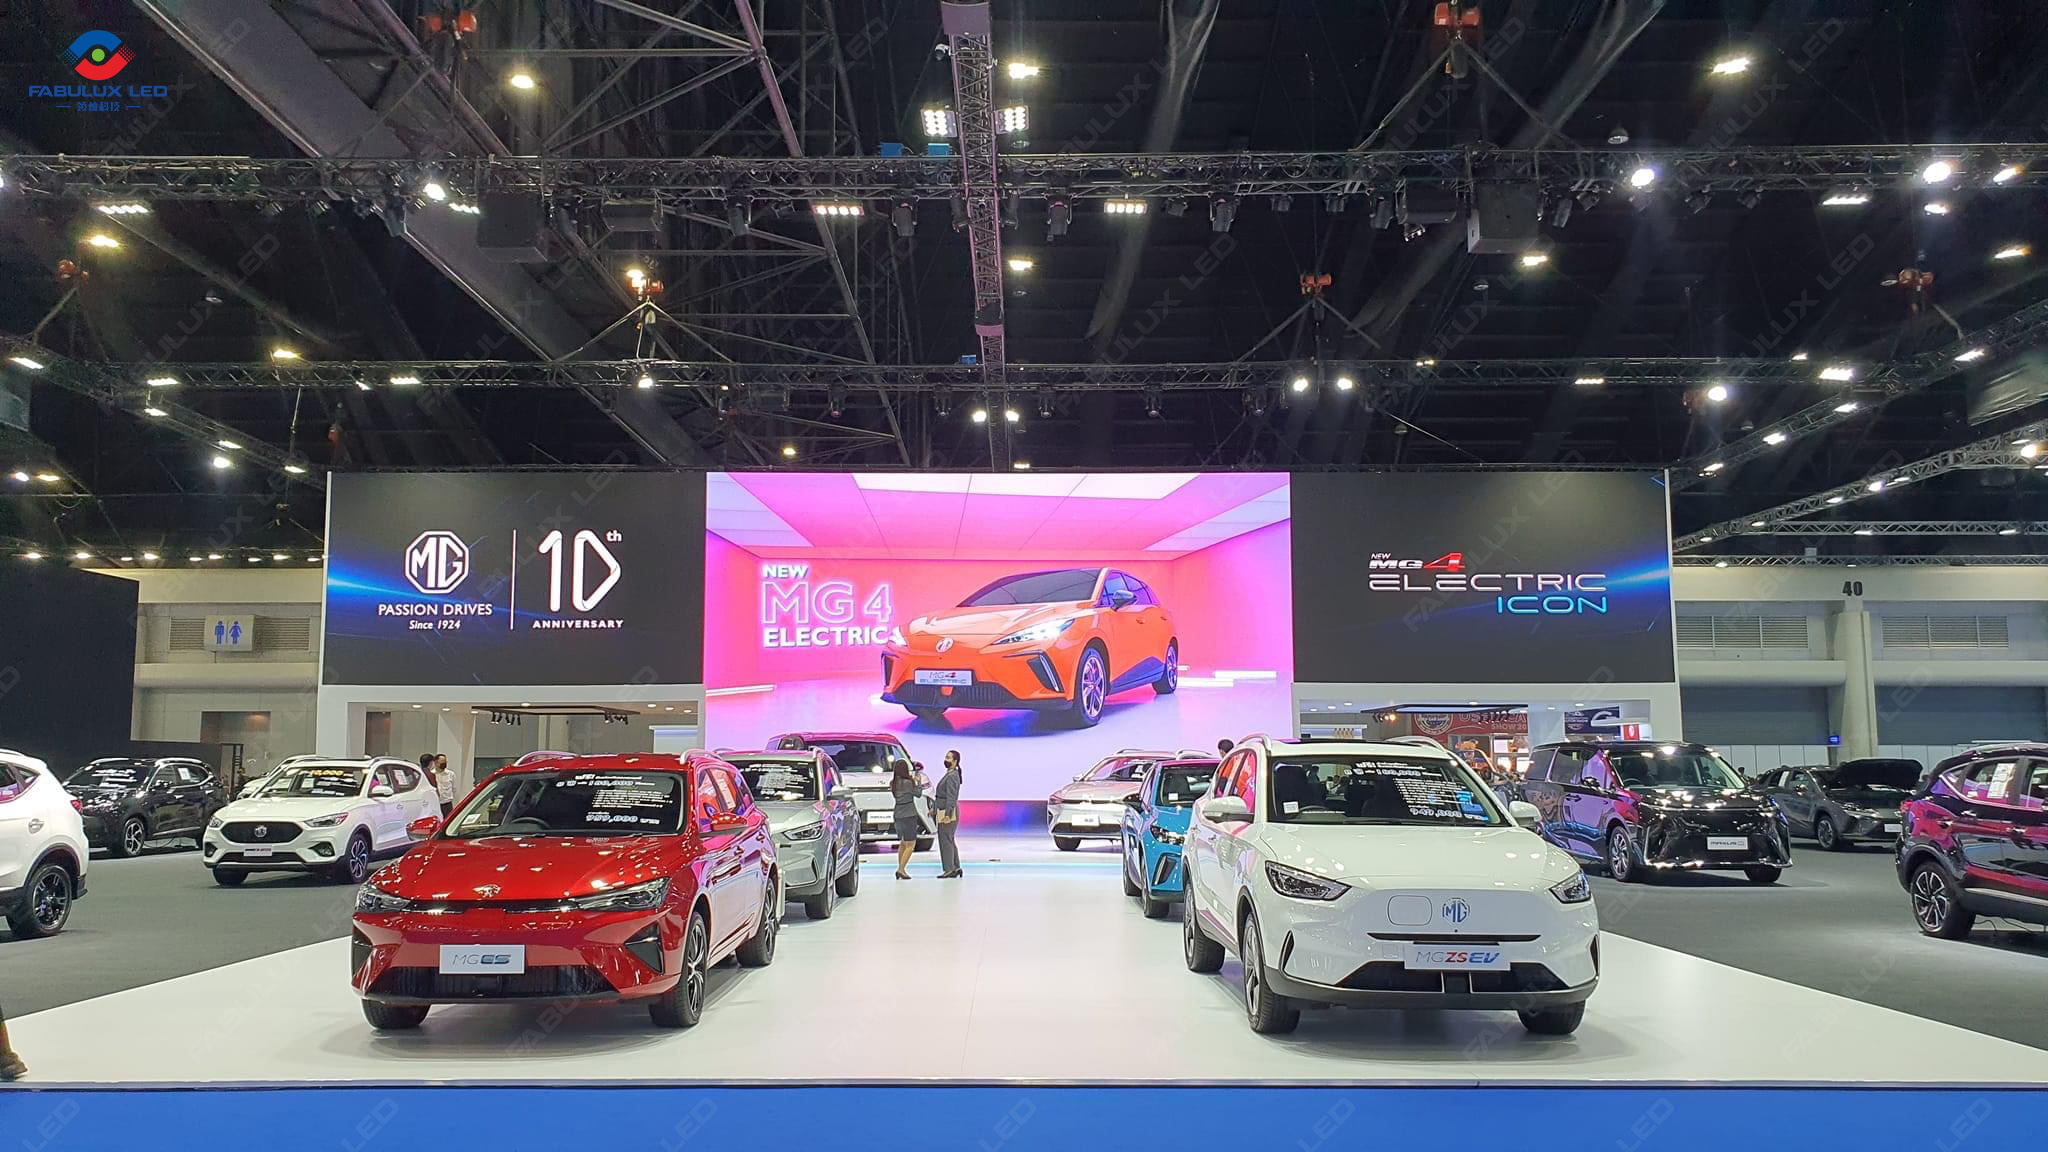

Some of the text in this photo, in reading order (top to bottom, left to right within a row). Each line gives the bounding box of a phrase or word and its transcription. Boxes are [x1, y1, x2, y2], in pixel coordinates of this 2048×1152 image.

[1370, 552, 1392, 560] NEW
[762, 564, 809, 579] NEW
[1368, 574, 1607, 592] ELECTRIC
[1842, 580, 1863, 597] 40
[378, 603, 493, 616] PASSION DRIVES
[761, 580, 892, 625] MG 4
[1496, 596, 1608, 614] ICON
[408, 619, 461, 630] Since 1924
[533, 619, 624, 629] ANNIVERSARY
[763, 624, 892, 648] ELECTRIC
